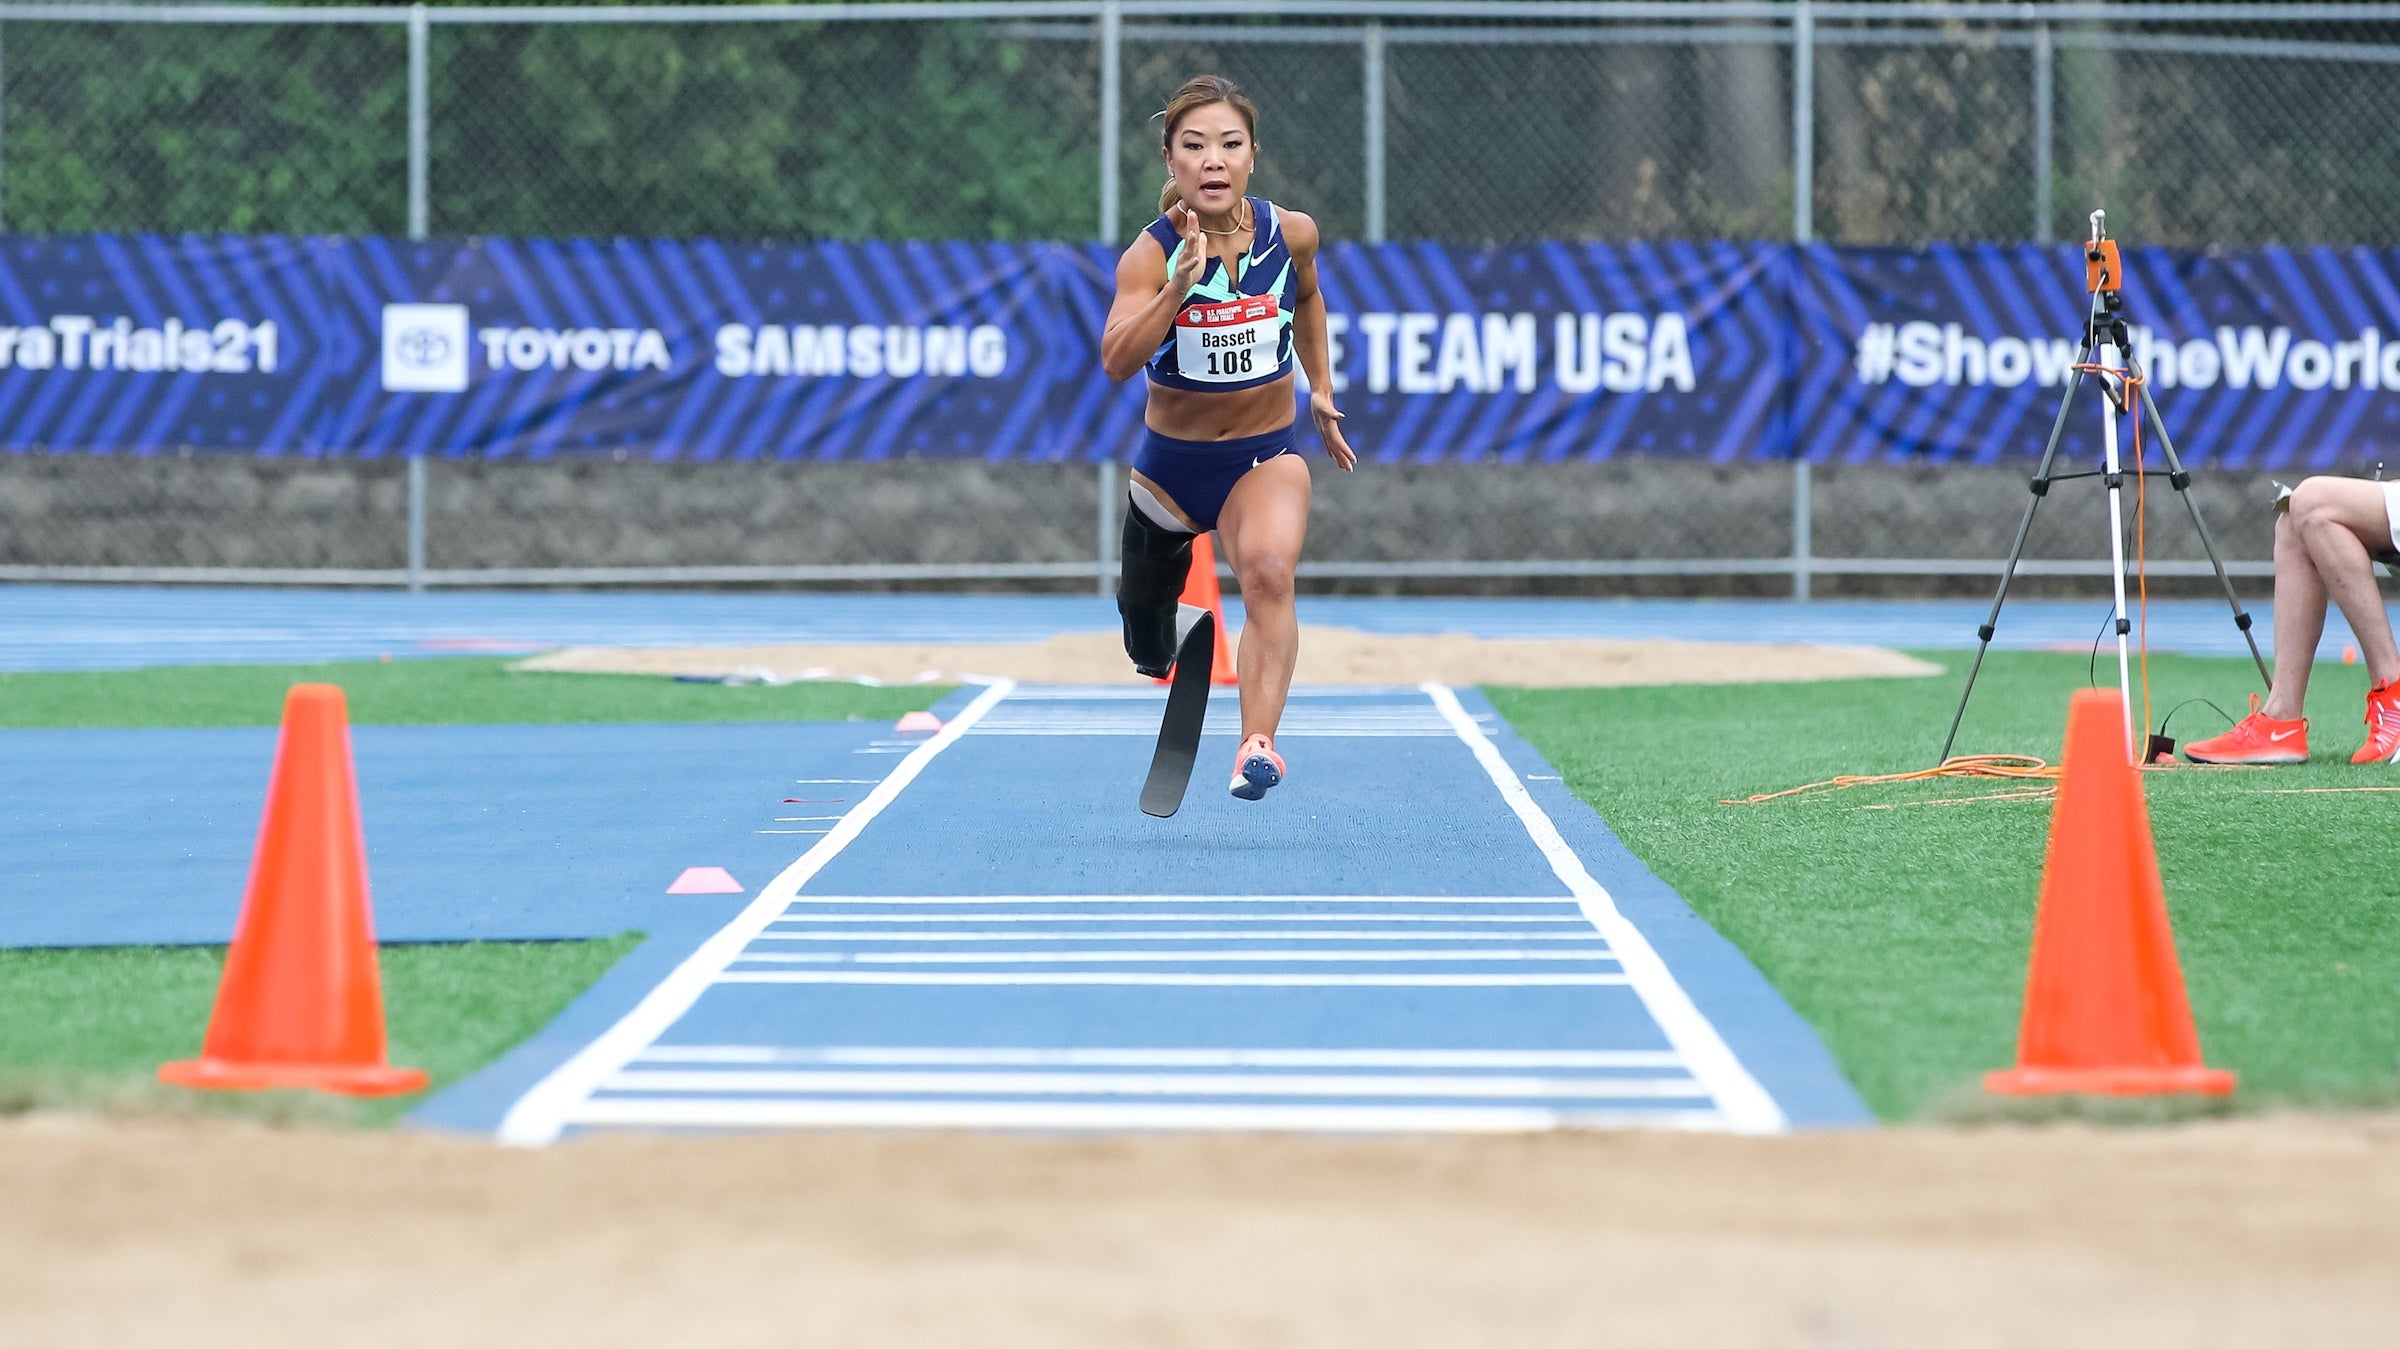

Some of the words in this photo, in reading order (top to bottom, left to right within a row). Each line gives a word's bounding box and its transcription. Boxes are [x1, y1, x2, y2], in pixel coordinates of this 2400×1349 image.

[477, 327, 672, 371] TOYOTA
[714, 322, 1008, 378] SAMSUNG
[1202, 328, 1256, 348] Bassett
[1207, 348, 1253, 375] 108
[1358, 311, 1537, 394] TEAM
[1554, 311, 1697, 394] USA
[1856, 320, 2400, 392] #ShowheWorl
